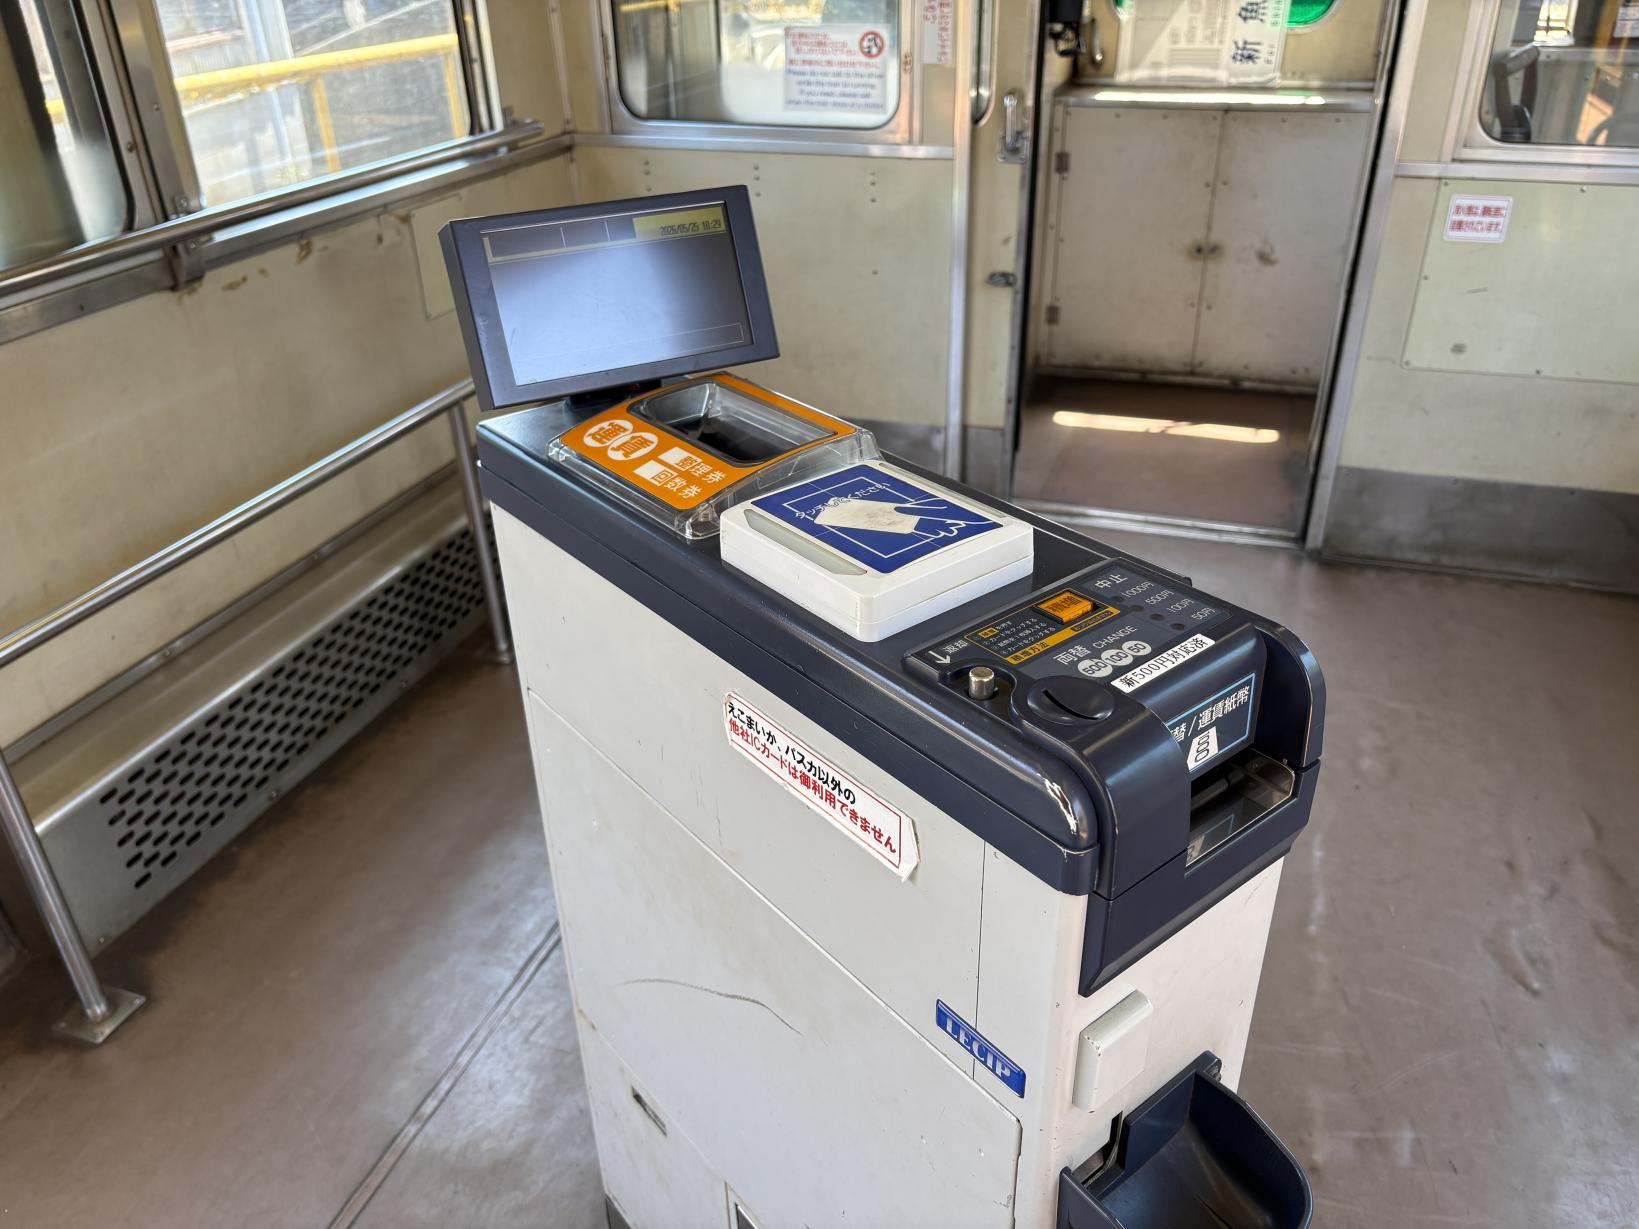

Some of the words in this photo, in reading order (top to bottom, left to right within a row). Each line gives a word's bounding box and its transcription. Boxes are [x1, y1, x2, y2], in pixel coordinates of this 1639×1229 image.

[651, 469, 703, 500] 回数券
[675, 454, 727, 484] 整理券
[1094, 573, 1129, 590] 中止
[1121, 580, 1155, 599] 1000円
[1144, 589, 1175, 606] 500円
[1166, 598, 1196, 614] 100円
[1191, 607, 1217, 621] 50円
[1053, 644, 1092, 666] 両替
[1094, 624, 1138, 650] CHANGE
[1083, 658, 1109, 675] 500
[1105, 651, 1129, 666] 100
[1128, 643, 1146, 656] 50
[1119, 633, 1210, 688] 新500円対応済
[1169, 685, 1251, 743] 替/運賃紙幣
[728, 717, 898, 855] 他社ICカードは御利用できません
[944, 1015, 1012, 1081] LECIP
